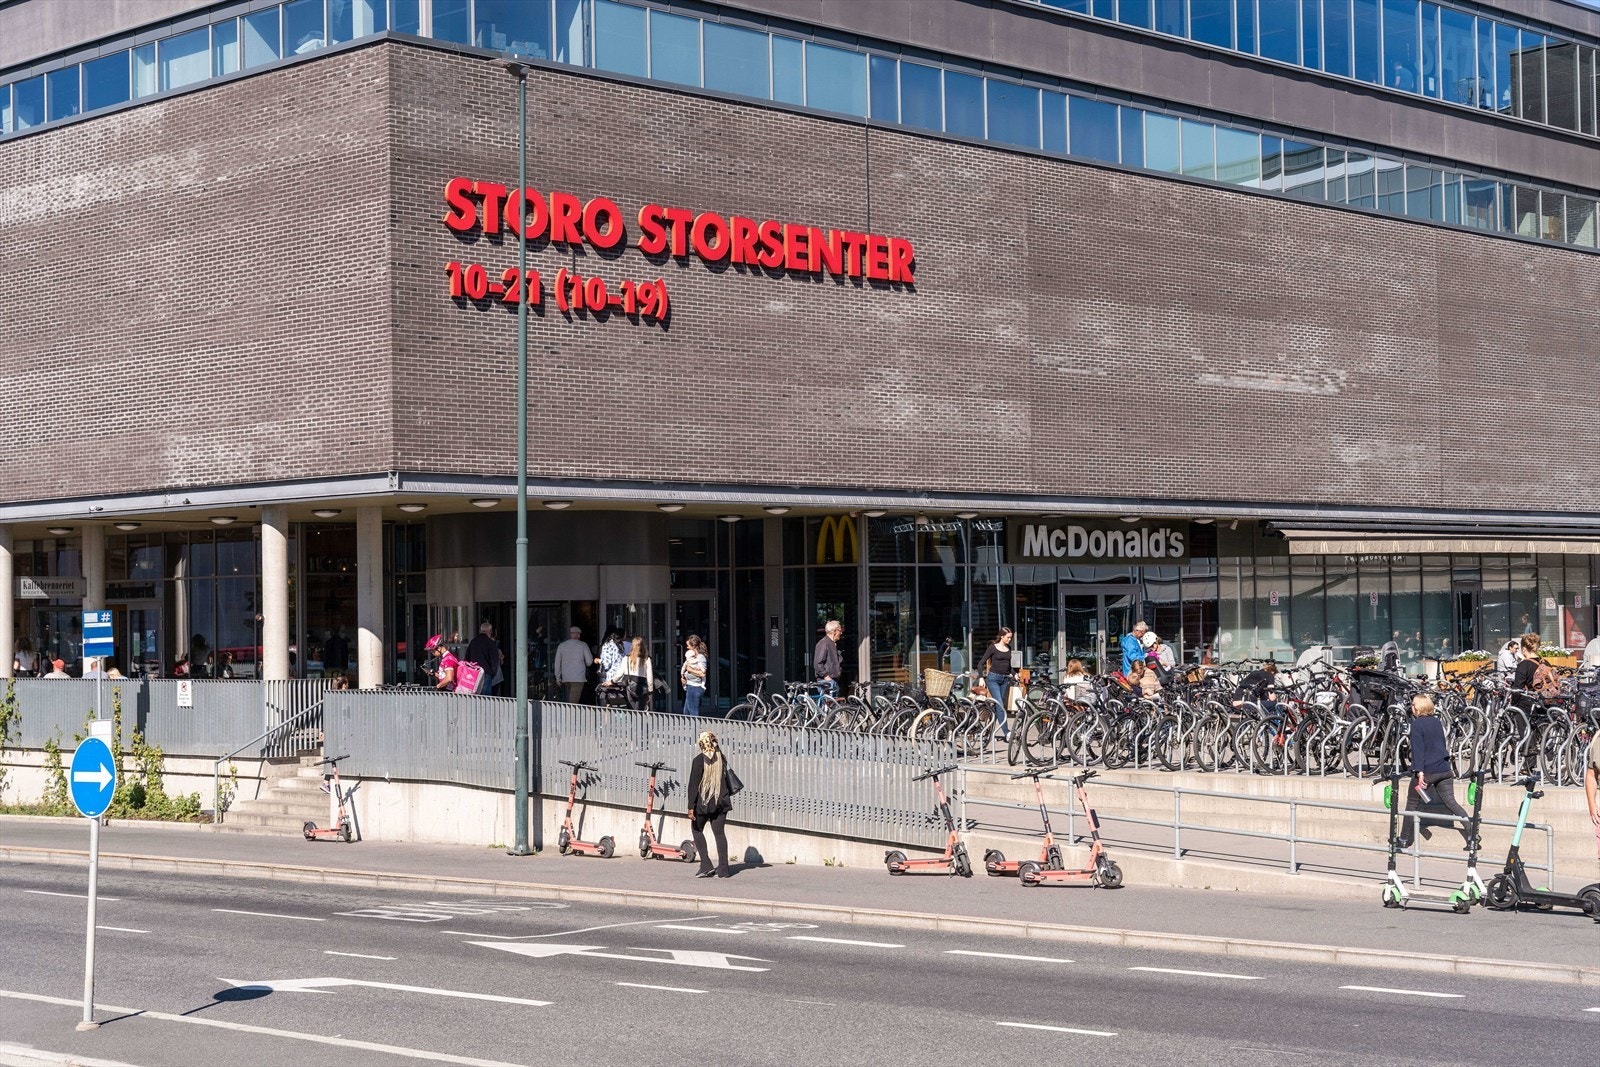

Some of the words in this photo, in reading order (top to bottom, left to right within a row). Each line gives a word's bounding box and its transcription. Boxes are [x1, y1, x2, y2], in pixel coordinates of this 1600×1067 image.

[443, 177, 624, 249] STORO
[637, 204, 915, 283] STORSENTER
[444, 262, 541, 305] 10-21
[554, 267, 668, 321] (10-19)
[1023, 525, 1185, 558] McDonald's
